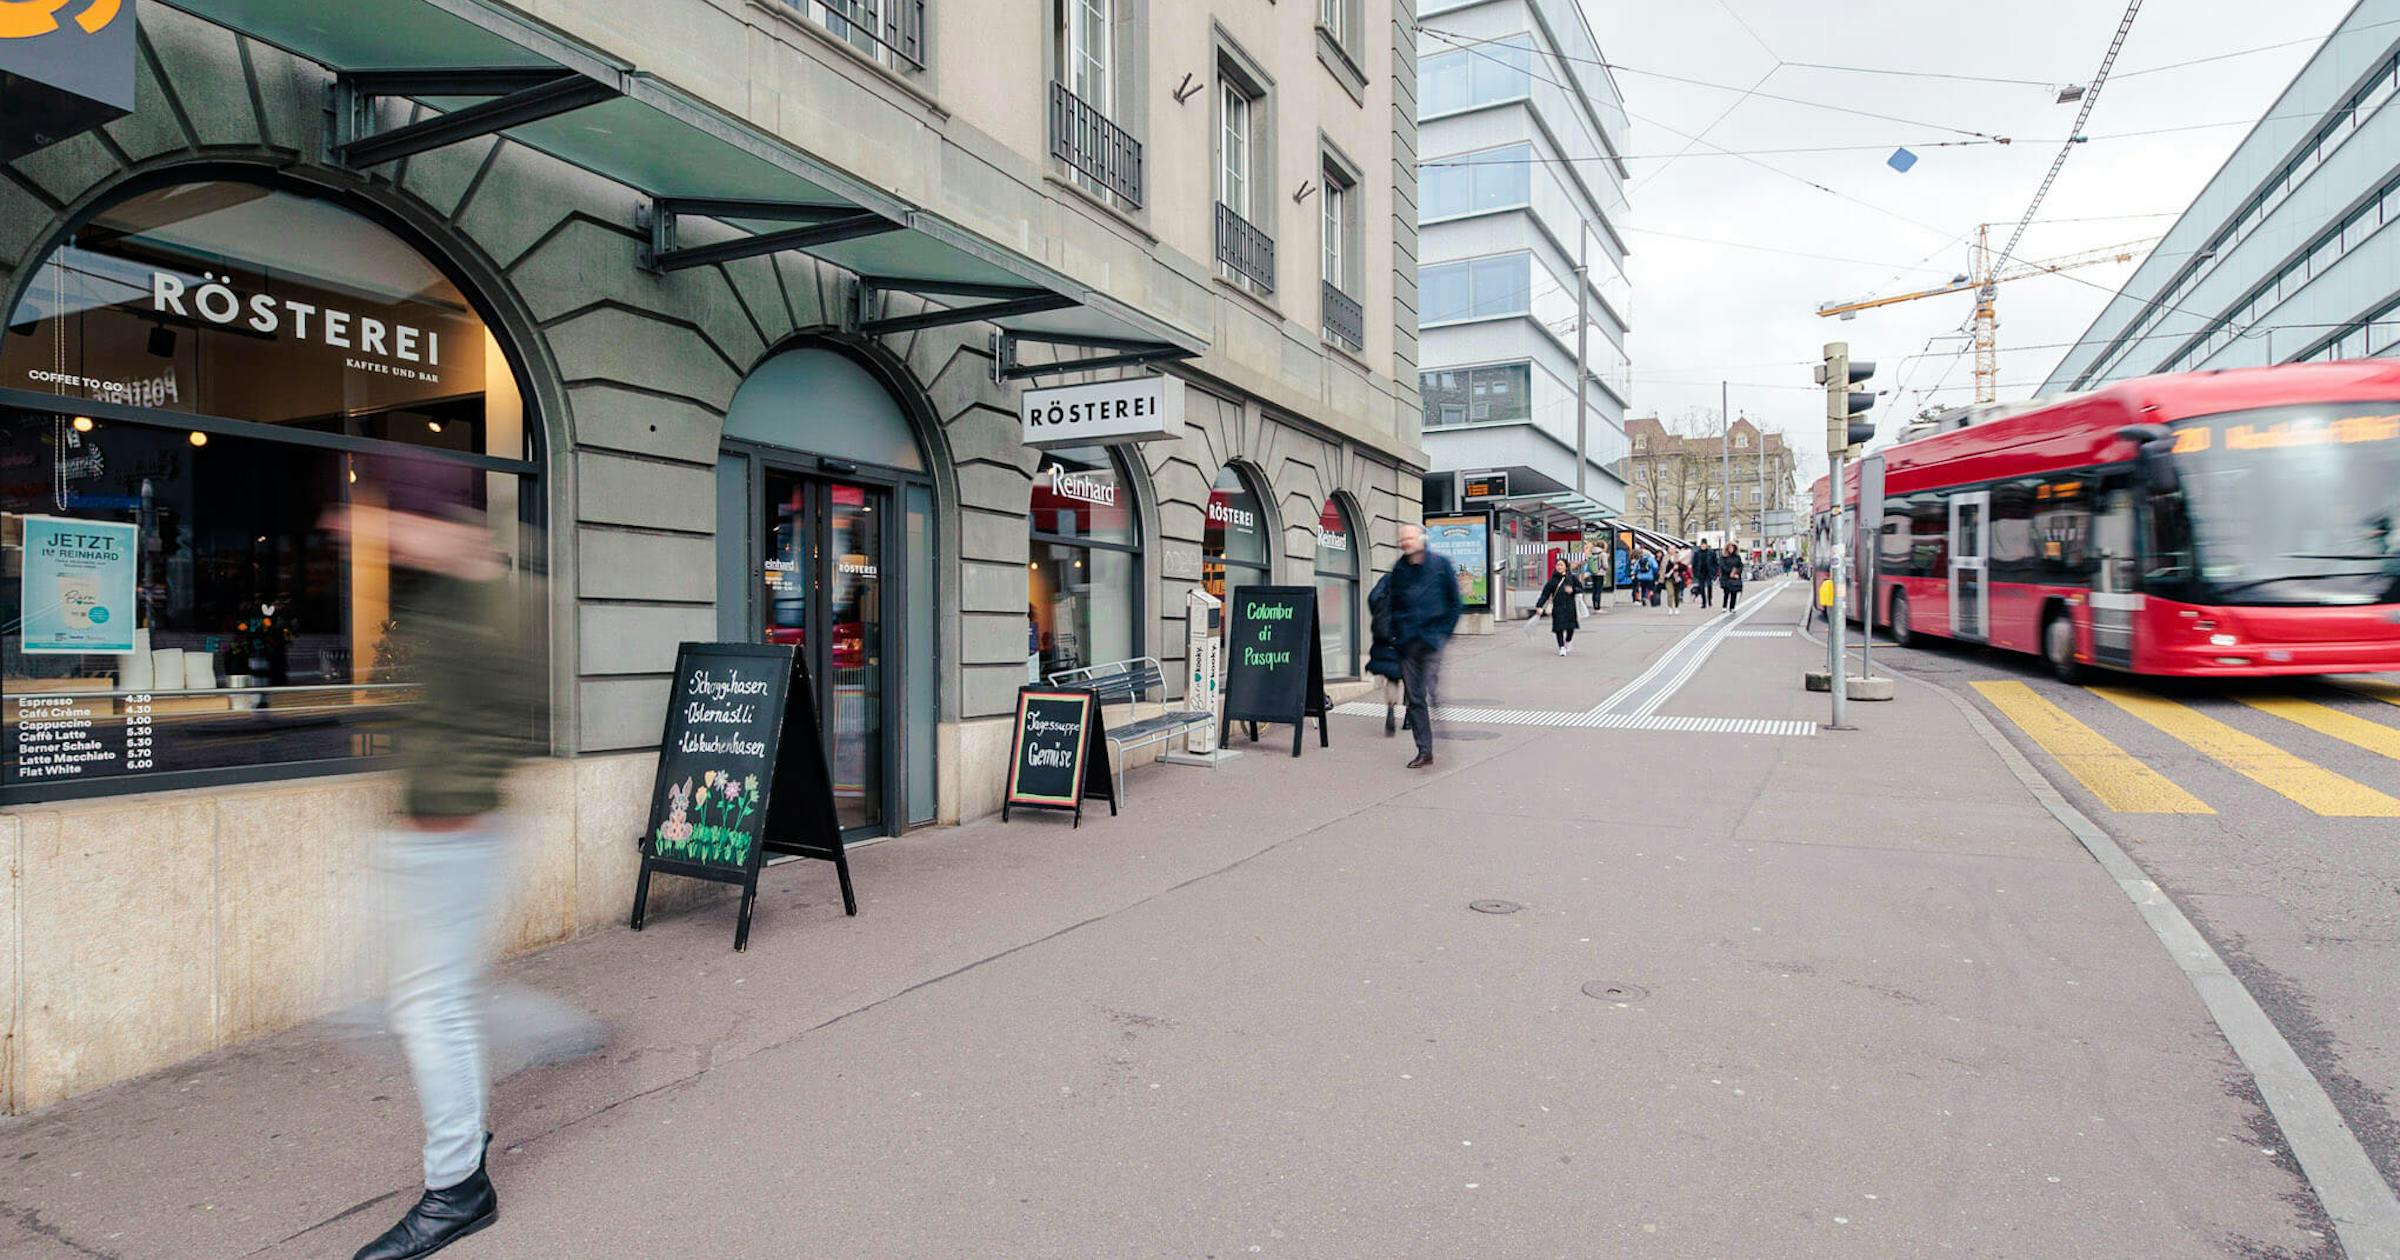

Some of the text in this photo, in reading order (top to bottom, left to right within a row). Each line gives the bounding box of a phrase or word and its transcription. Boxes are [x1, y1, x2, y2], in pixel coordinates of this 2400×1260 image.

[154, 271, 439, 366] RÖSTEREI
[346, 358, 439, 383] KAFFEE UND BAR
[28, 369, 123, 392] COFFEE TO GO
[1030, 396, 1155, 427] RÖSTEREI
[1051, 462, 1115, 505] Reinhard
[1208, 501, 1254, 527] RÖSTEREI
[48, 533, 115, 550] JETZT
[59, 549, 119, 561] REINHARD
[1247, 602, 1294, 620] Colomba
[1259, 624, 1271, 641] di
[1244, 647, 1291, 671] Pasqua
[19, 694, 152, 709] Espresso 4.30
[19, 705, 152, 719] Café Crème 4.30
[19, 716, 152, 731] Cappuccino 5.00
[1027, 710, 1080, 737] Tagessuppe
[19, 727, 153, 743] Caffè Latte 5.30
[19, 737, 153, 754] Berner Schale 5.30
[19, 748, 152, 766] Latte Macchiato 5.70
[1028, 742, 1072, 768] Gemüse
[19, 759, 153, 777] Flat White 6.00
